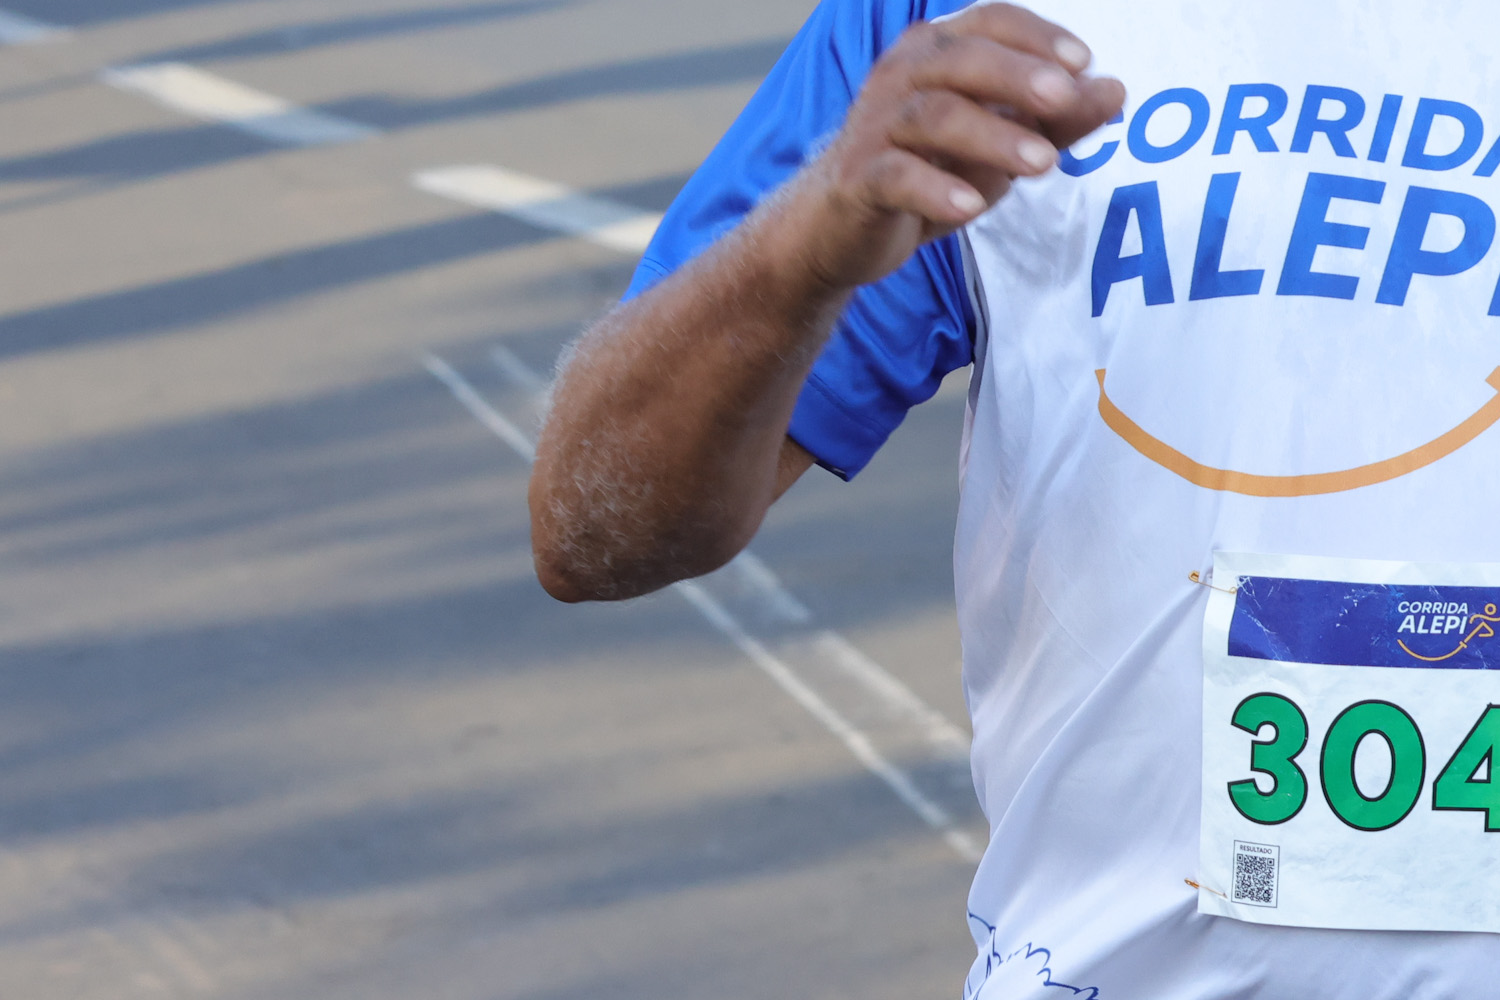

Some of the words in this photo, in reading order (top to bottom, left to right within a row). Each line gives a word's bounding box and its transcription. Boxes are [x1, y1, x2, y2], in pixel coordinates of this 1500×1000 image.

[1397, 601, 1469, 615] CORRIDA
[1397, 615, 1469, 635] ALEPI
[1239, 844, 1273, 855] RESULTADO
